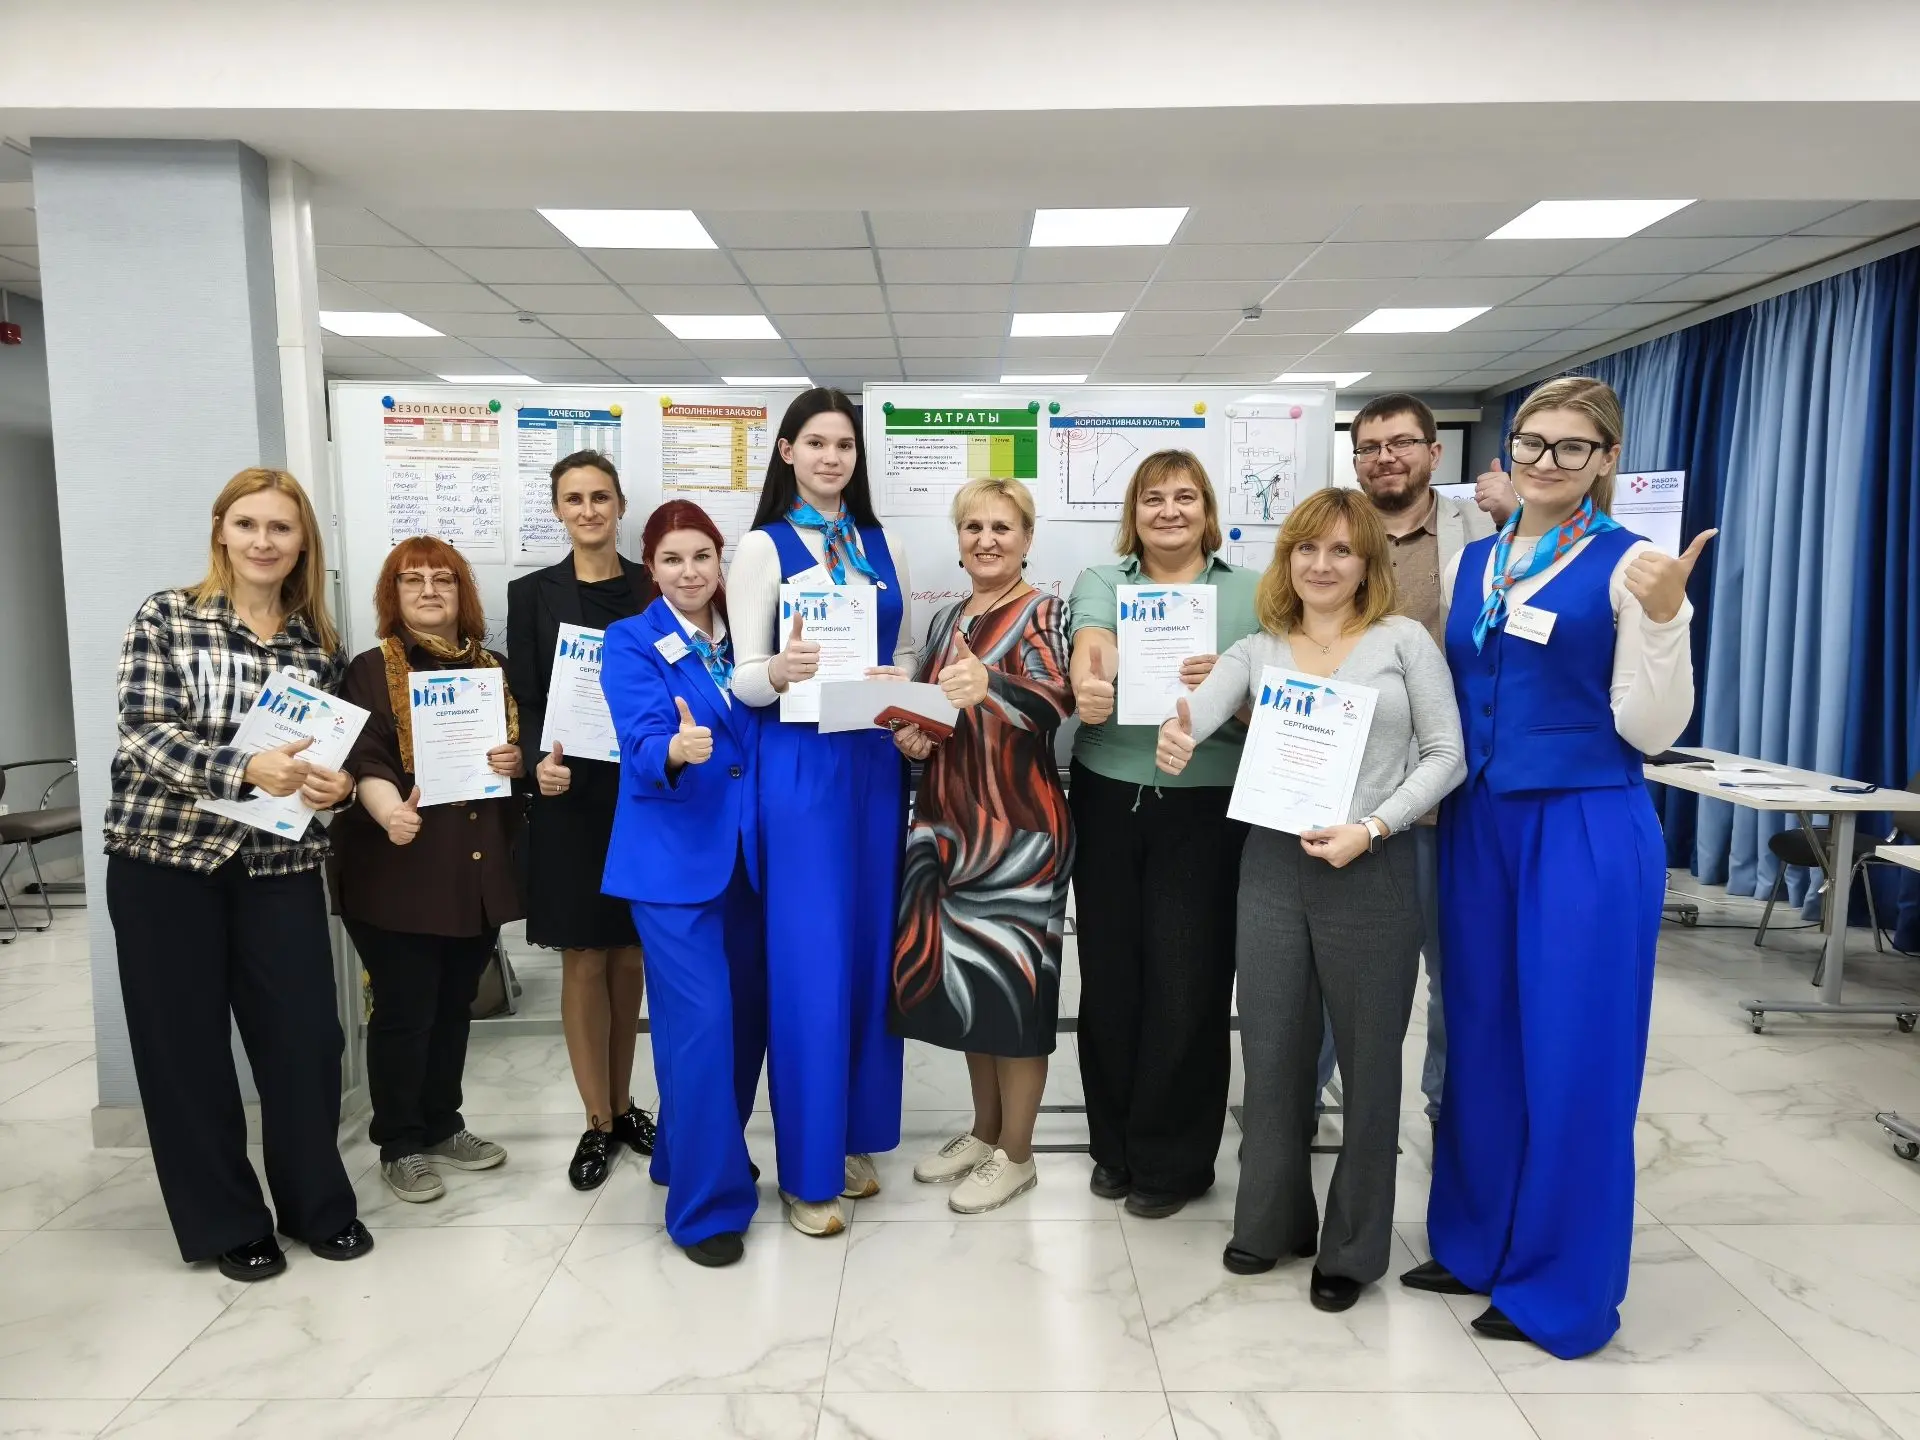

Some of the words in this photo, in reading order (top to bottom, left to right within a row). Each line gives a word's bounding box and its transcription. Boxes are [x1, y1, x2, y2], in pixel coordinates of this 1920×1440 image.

[548, 409, 591, 418] КАЧЕСТВО
[667, 406, 724, 416] ИСПОЛНЕНИЕ
[725, 408, 762, 417] ЗАКАЗОВ
[923, 412, 1000, 423] ЗАТРАТЫ
[1075, 418, 1141, 427] КОРПОРАТИВНАЯ
[1143, 419, 1181, 427] КУЛЬТУРА
[1144, 625, 1190, 633] СЕРТИФИКАТ
[579, 666, 600, 675] СЕРТИ
[435, 708, 479, 717] СЕРТИФИКАТ
[1283, 719, 1336, 736] СЕРТИФИКАТ
